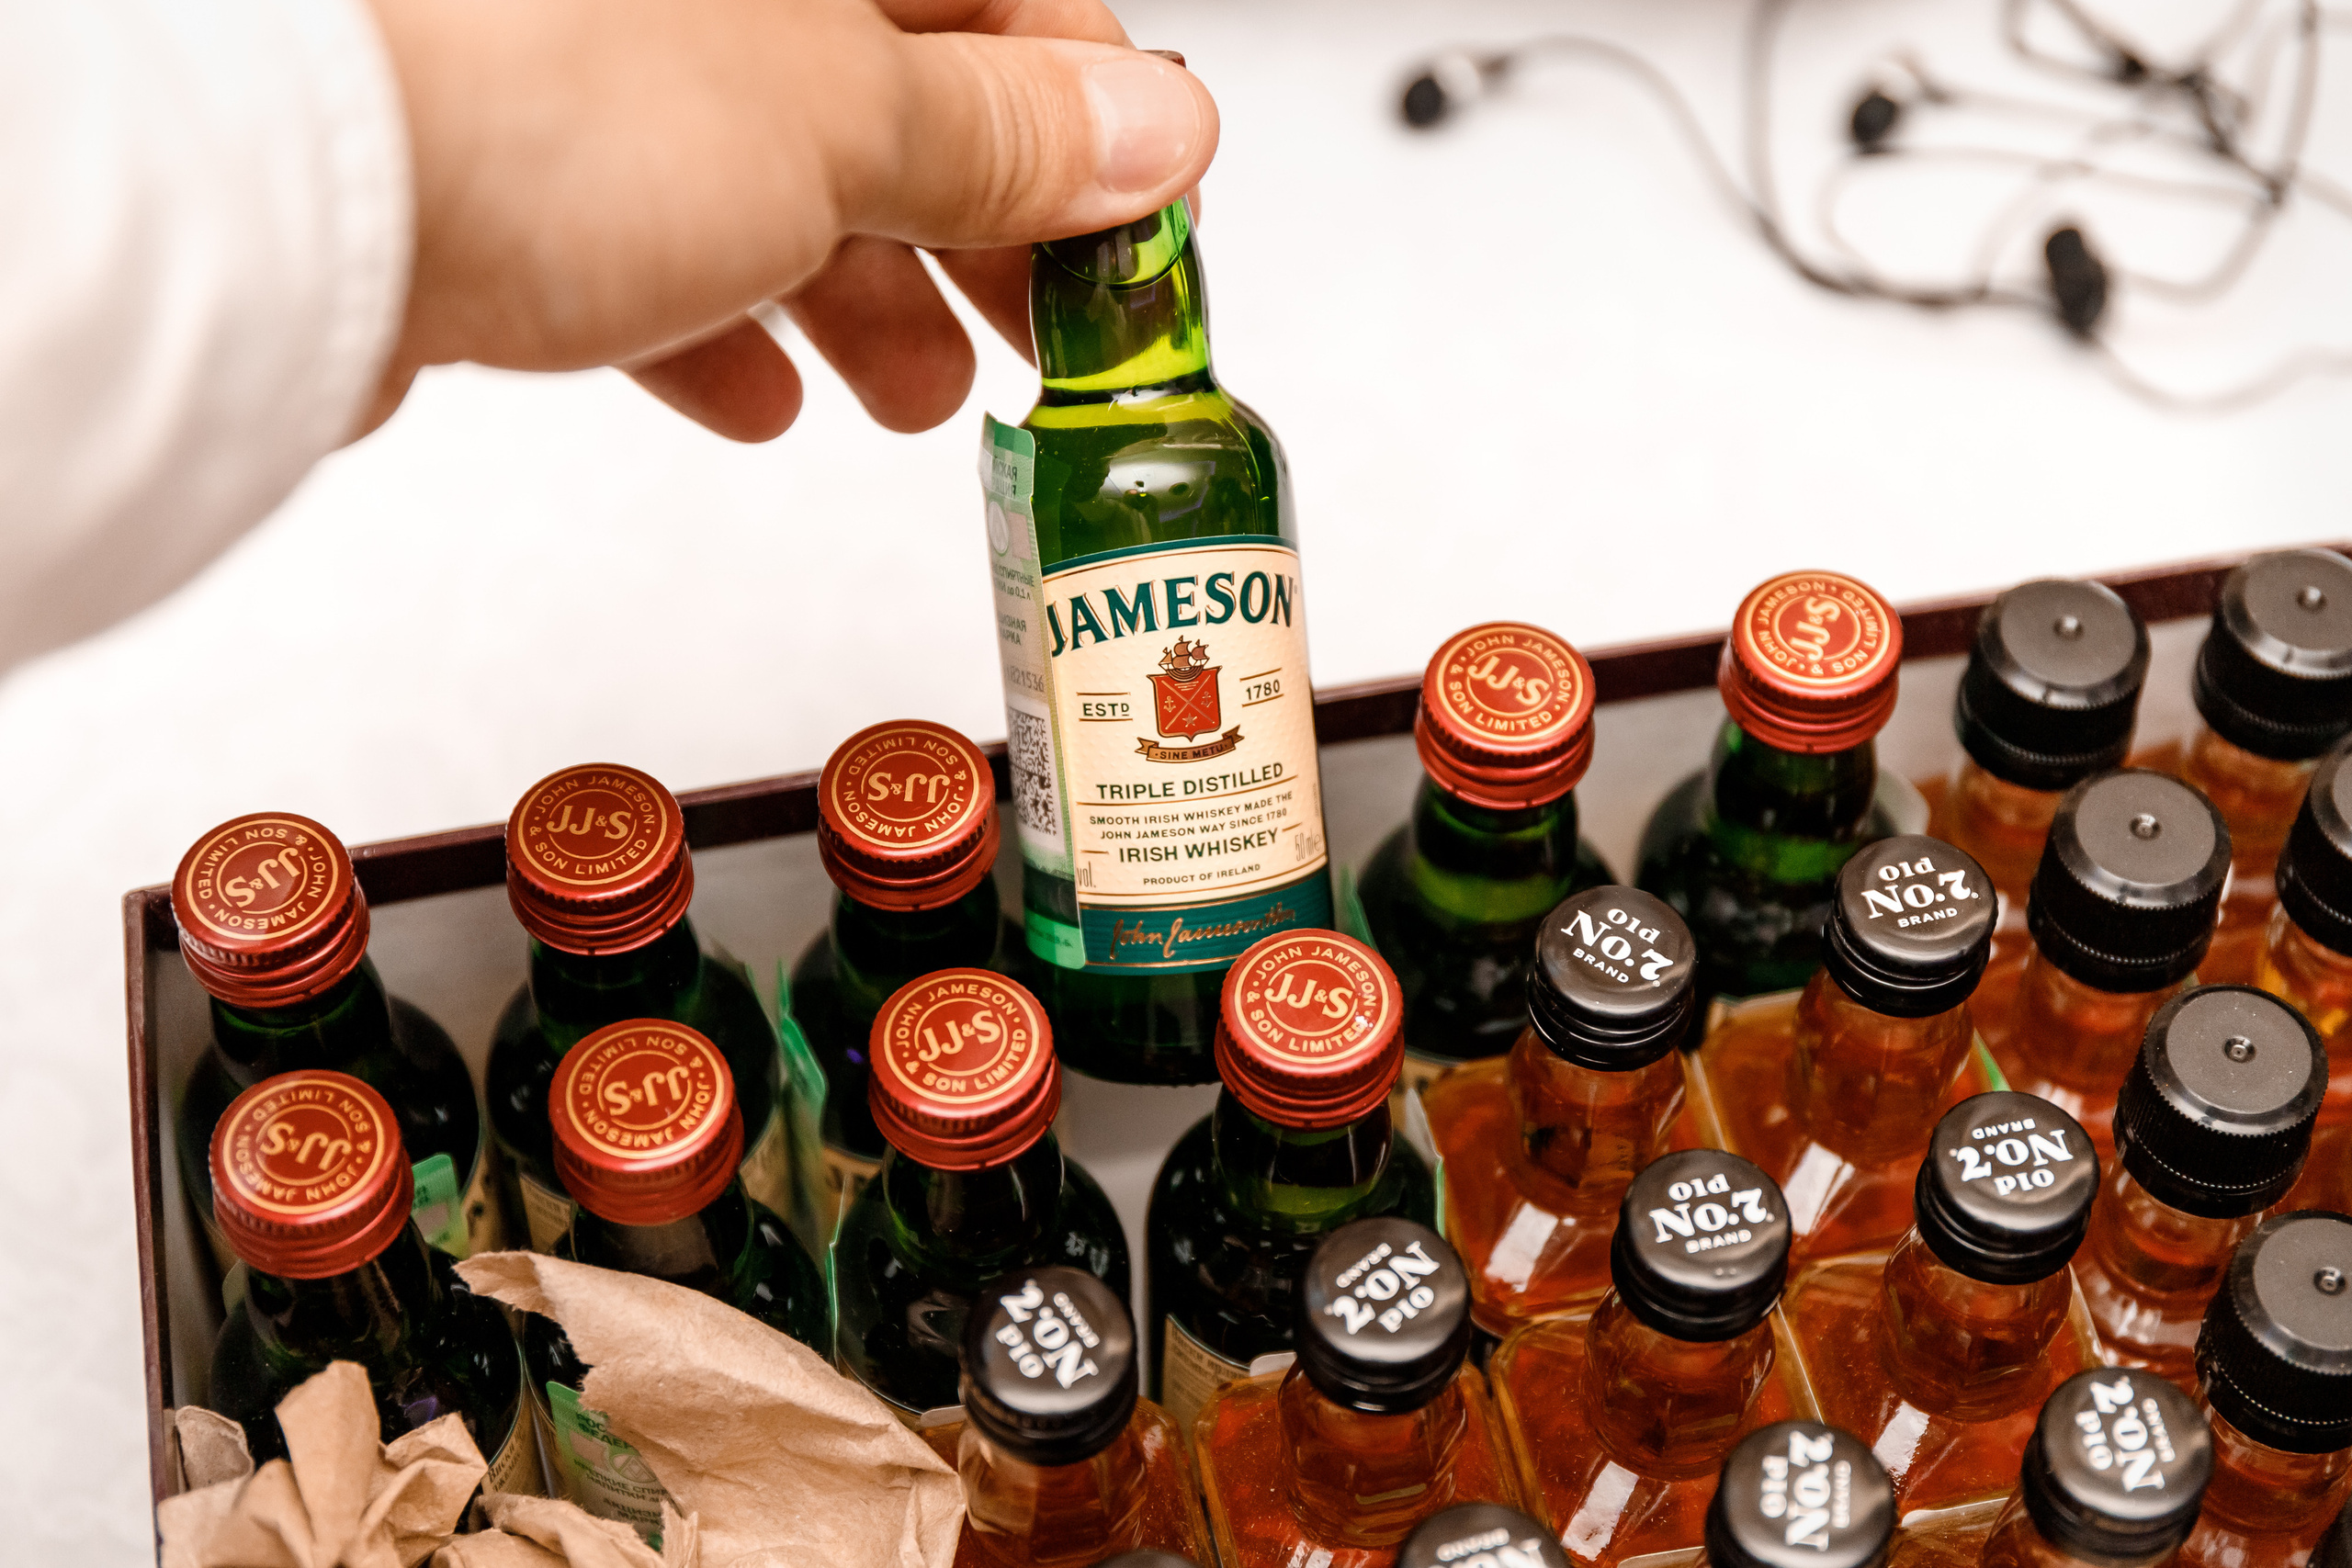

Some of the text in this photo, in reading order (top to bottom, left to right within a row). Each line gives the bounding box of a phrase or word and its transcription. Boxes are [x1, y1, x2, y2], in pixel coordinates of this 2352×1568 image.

[1046, 570, 1294, 657] JAMESON
[1758, 582, 1826, 625] JAMESON
[1842, 590, 1877, 649] LIMITED
[1467, 636, 1514, 657] JOHN
[1791, 596, 1840, 662] JJ&S
[1758, 630, 1798, 667] JOHN
[1832, 649, 1868, 672] SON
[1467, 655, 1549, 705] JJ&S
[1522, 638, 1572, 703] JAMESON
[1246, 681, 1280, 701] 1780
[1450, 681, 1474, 714] SON
[1476, 711, 1553, 731] LIMITED
[849, 737, 915, 775] LIMITED
[923, 740, 957, 765] SON
[1160, 744, 1223, 760] SINE METU
[536, 780, 579, 813] JOHN
[867, 773, 950, 803] JJ&S
[1096, 762, 1283, 799] TRIPLE DISTILLED
[587, 776, 655, 824] JAMESON
[843, 791, 915, 837] JAMESON
[924, 794, 964, 832] JOHN
[1090, 791, 1293, 825] SMOOTH IRISH WHISKEY MADE THE
[245, 828, 288, 840] SON
[547, 806, 631, 840] JJ&S
[1101, 808, 1286, 840] JOHN JAMESON WAY SINCE 1780
[536, 842, 569, 870] SON
[575, 839, 647, 874] LIMITED
[1119, 828, 1278, 863] IRISH WHISKEY
[198, 837, 239, 899] LIMITED
[225, 848, 300, 908] JJ&S
[308, 855, 325, 897] JOHN
[1077, 862, 1096, 888] vol.
[1143, 875, 1194, 885] PRODUCT
[1217, 863, 1261, 878] IRELAND
[215, 901, 306, 930] JAMESON
[1897, 908, 1957, 928] BRAND
[1256, 946, 1303, 980] JOHN
[1311, 946, 1376, 1007] JAMESON
[1573, 948, 1629, 983] BRAND
[928, 984, 1017, 1016] JAMESON
[1264, 973, 1353, 1019] JJ&S
[896, 1002, 922, 1048] JOHN
[919, 1010, 1001, 1062] JJ&S
[1250, 1009, 1284, 1043] SON
[1289, 1021, 1367, 1053] LIMITED
[646, 1036, 687, 1055] SON
[974, 1029, 1026, 1090] LIMITED
[579, 1038, 637, 1095] LIMITED
[922, 1073, 967, 1092] SON
[253, 1089, 334, 1121] LIMITED
[604, 1066, 688, 1116] JJ&S
[679, 1081, 710, 1131] JOHN
[339, 1100, 370, 1134] SON
[583, 1109, 674, 1147] JAMESON
[1972, 1118, 2036, 1139] BRAND
[260, 1122, 352, 1171] JJ&S
[235, 1134, 296, 1202] JAMESON
[306, 1164, 358, 1201] JOHN
[1686, 1229, 1752, 1253] BRAND
